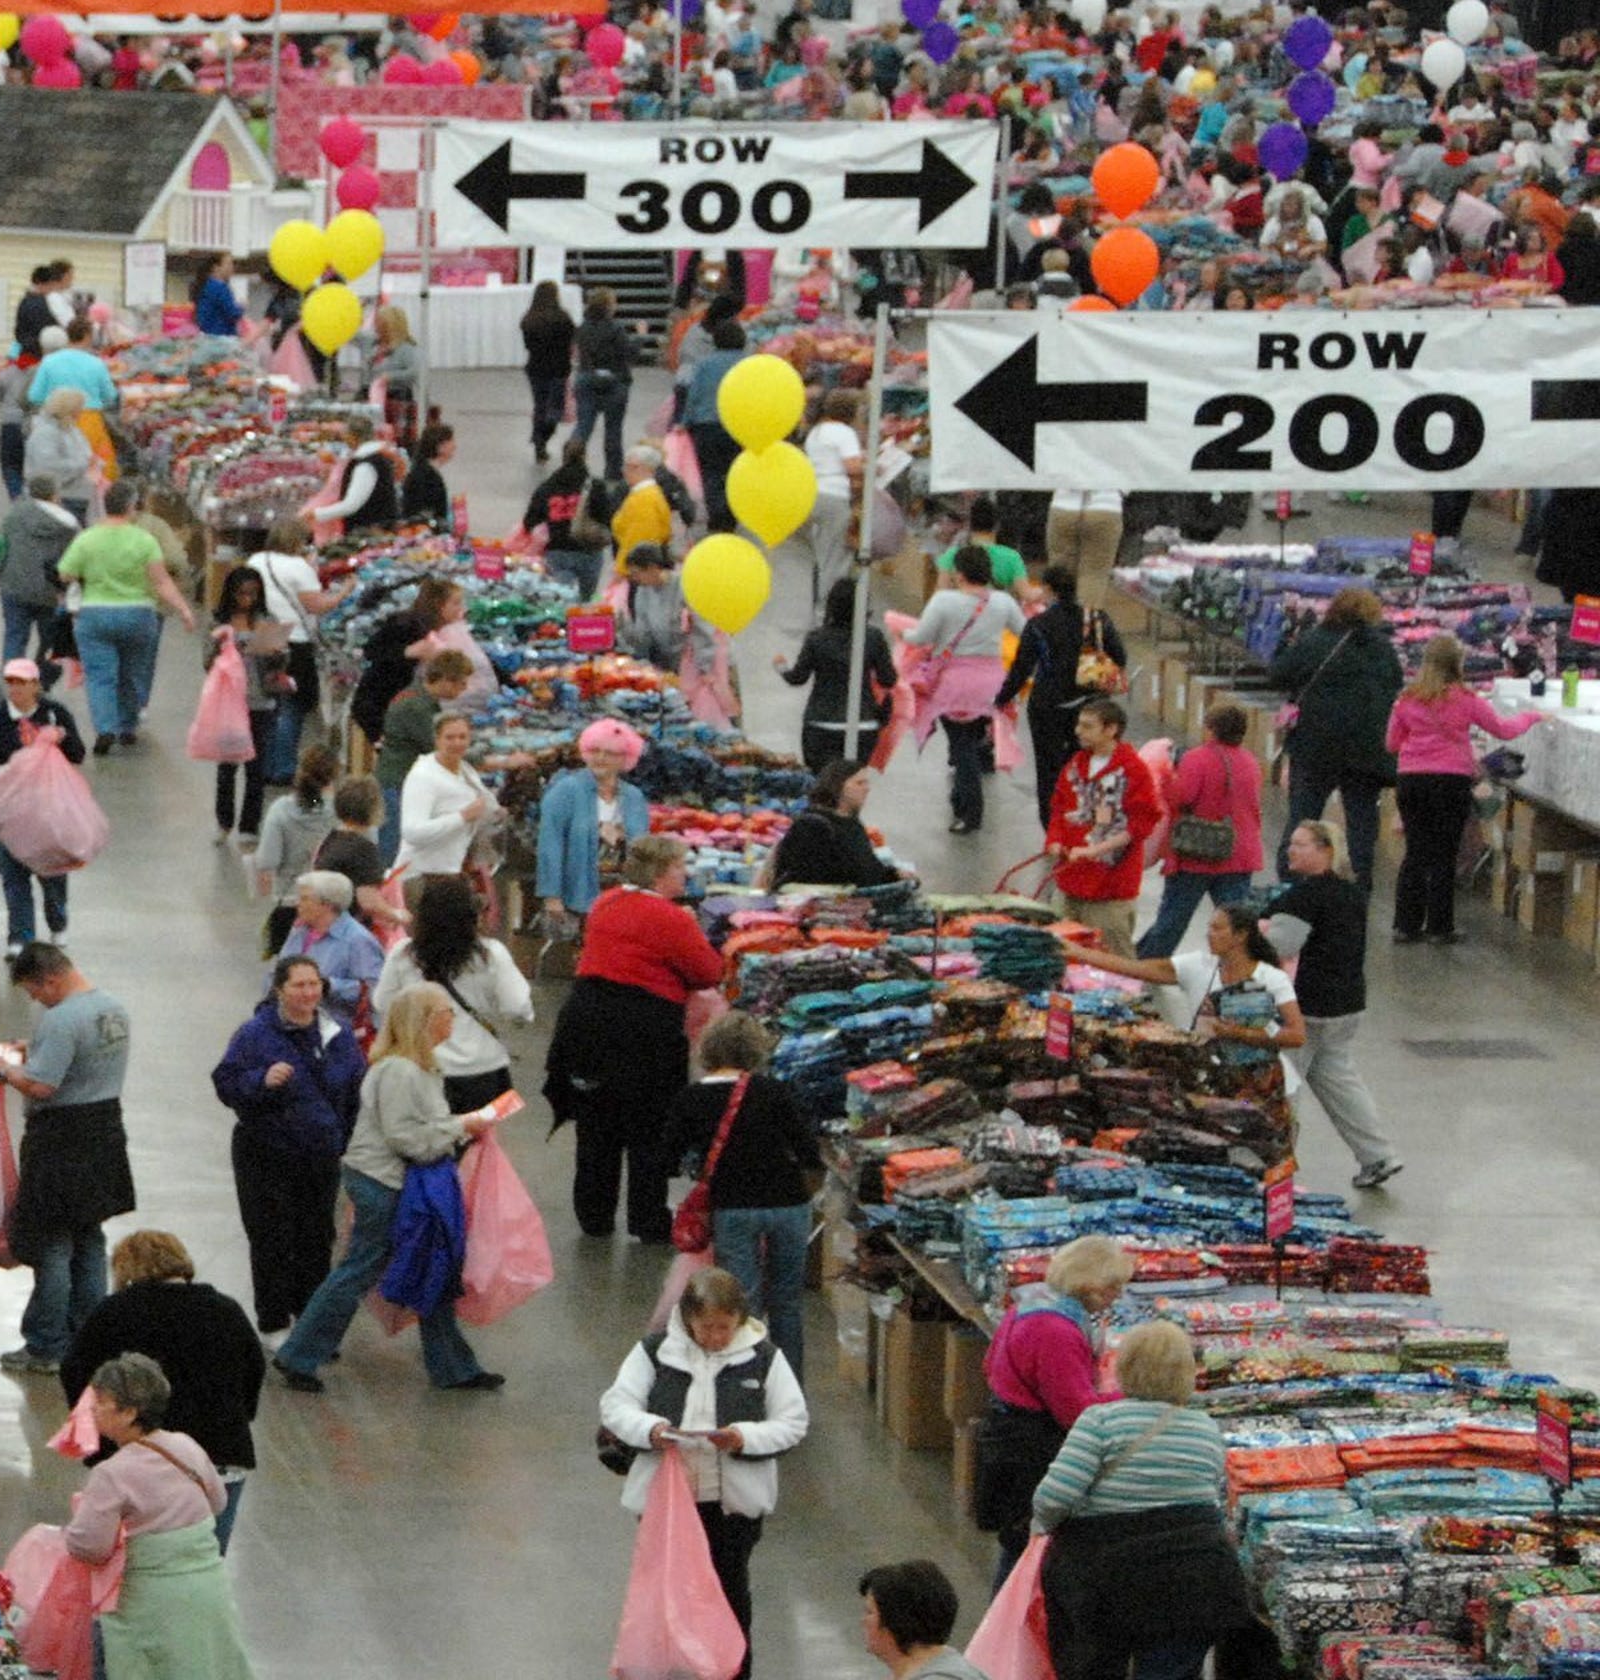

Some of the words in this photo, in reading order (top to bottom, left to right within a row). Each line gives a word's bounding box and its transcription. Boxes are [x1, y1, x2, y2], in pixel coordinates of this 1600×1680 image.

[660, 138, 771, 164] ROW
[615, 180, 812, 235] 300
[1257, 331, 1426, 371] ROW
[1190, 393, 1486, 473] 200
